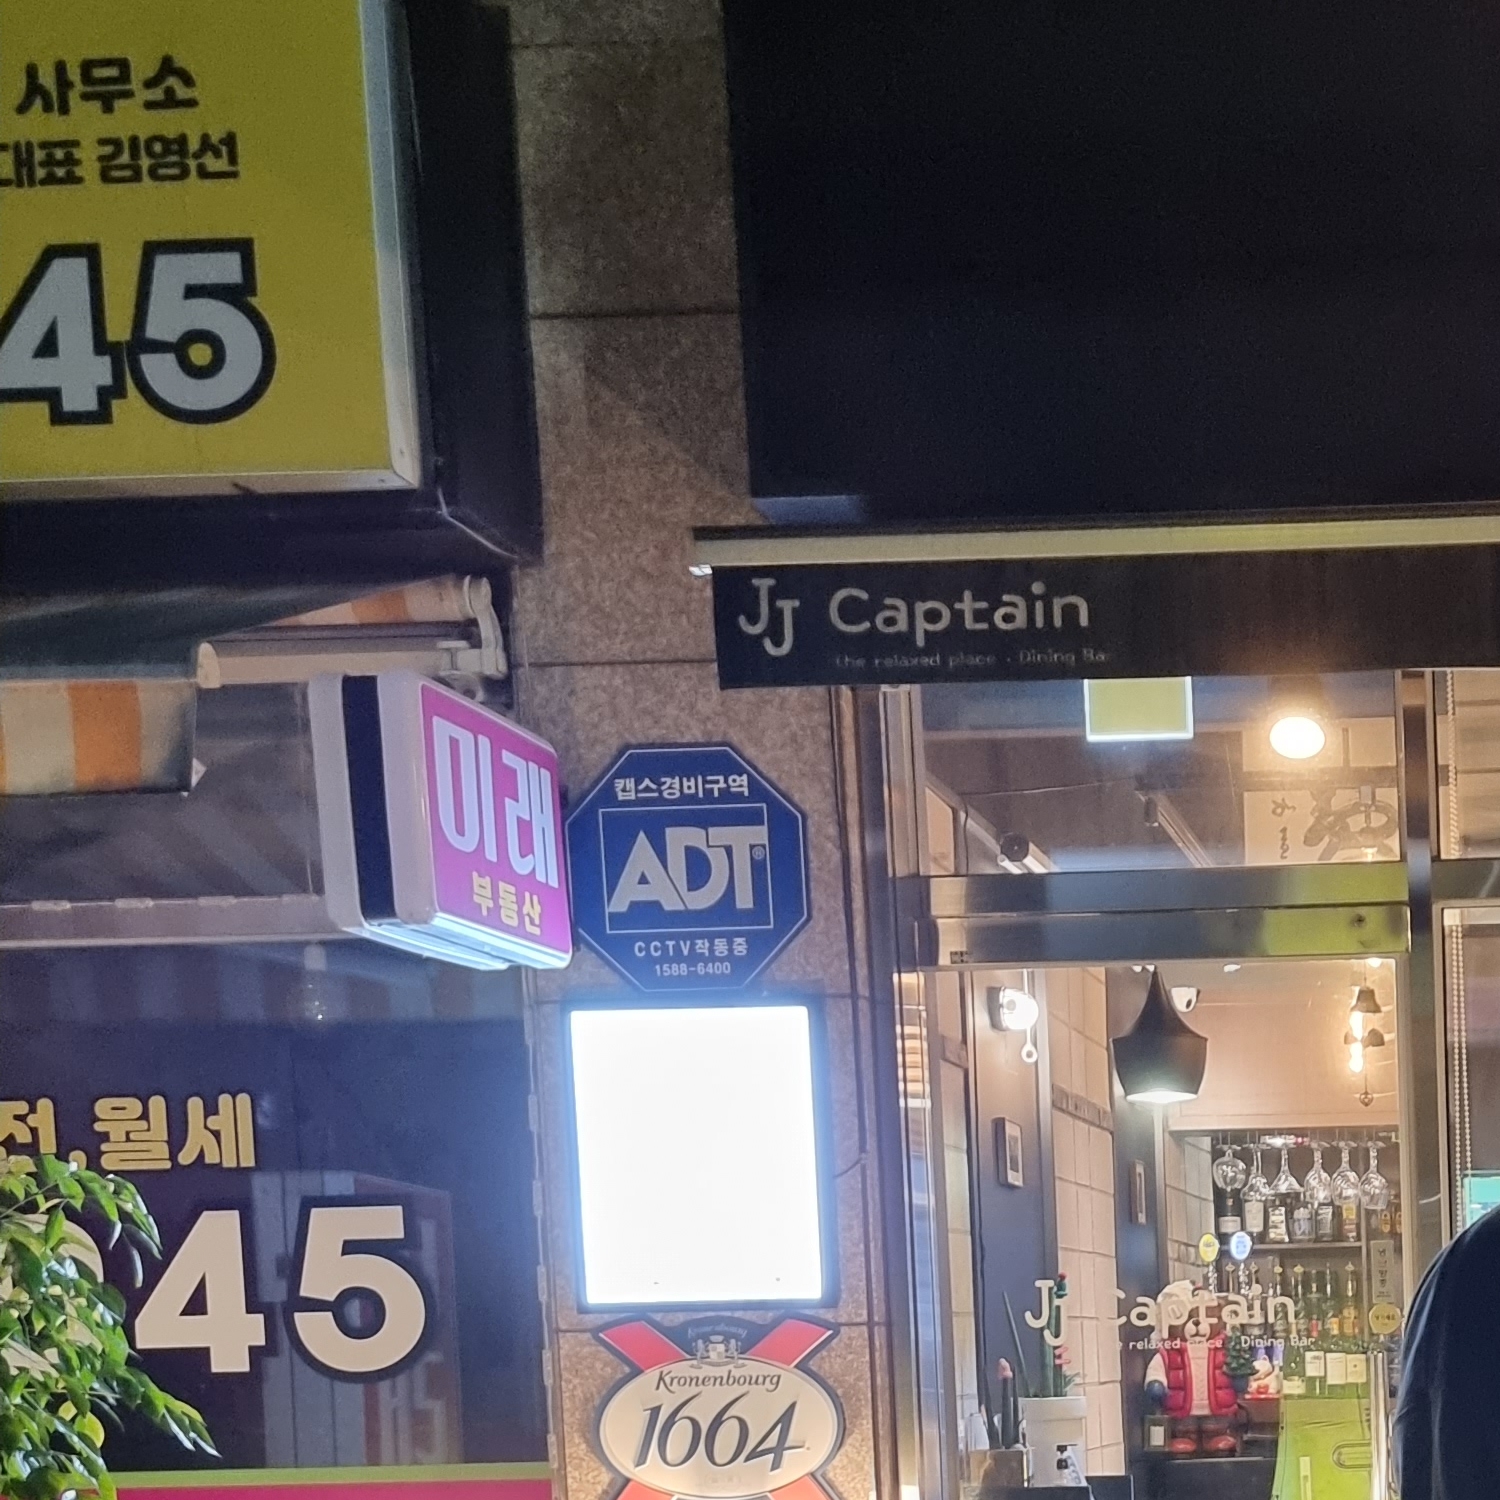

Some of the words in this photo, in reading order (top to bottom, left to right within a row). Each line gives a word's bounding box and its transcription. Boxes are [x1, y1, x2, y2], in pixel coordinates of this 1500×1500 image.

[15, 54, 200, 116] 사무소
[0, 138, 85, 188] 대표
[96, 130, 240, 184] 김영선
[0, 237, 277, 425] 45
[828, 580, 1089, 648] Captain
[836, 654, 866, 669] the
[874, 653, 941, 668] relaxed
[949, 653, 996, 670] place
[1018, 648, 1076, 668] Dining
[1082, 647, 1111, 663] Ba
[432, 715, 559, 889] 미래
[614, 773, 750, 801] 캡스경비구역
[608, 825, 768, 913] ADT
[472, 871, 542, 937] 부동산
[634, 937, 749, 958] CCTV작동중
[655, 962, 732, 977] 1588-6400
[1129, 1337, 1181, 1350] relaxed
[1241, 1334, 1284, 1350] Dining
[1290, 1335, 1315, 1347] Bar
[655, 1370, 782, 1394] Kronenbourg
[634, 1391, 807, 1474] 1664
